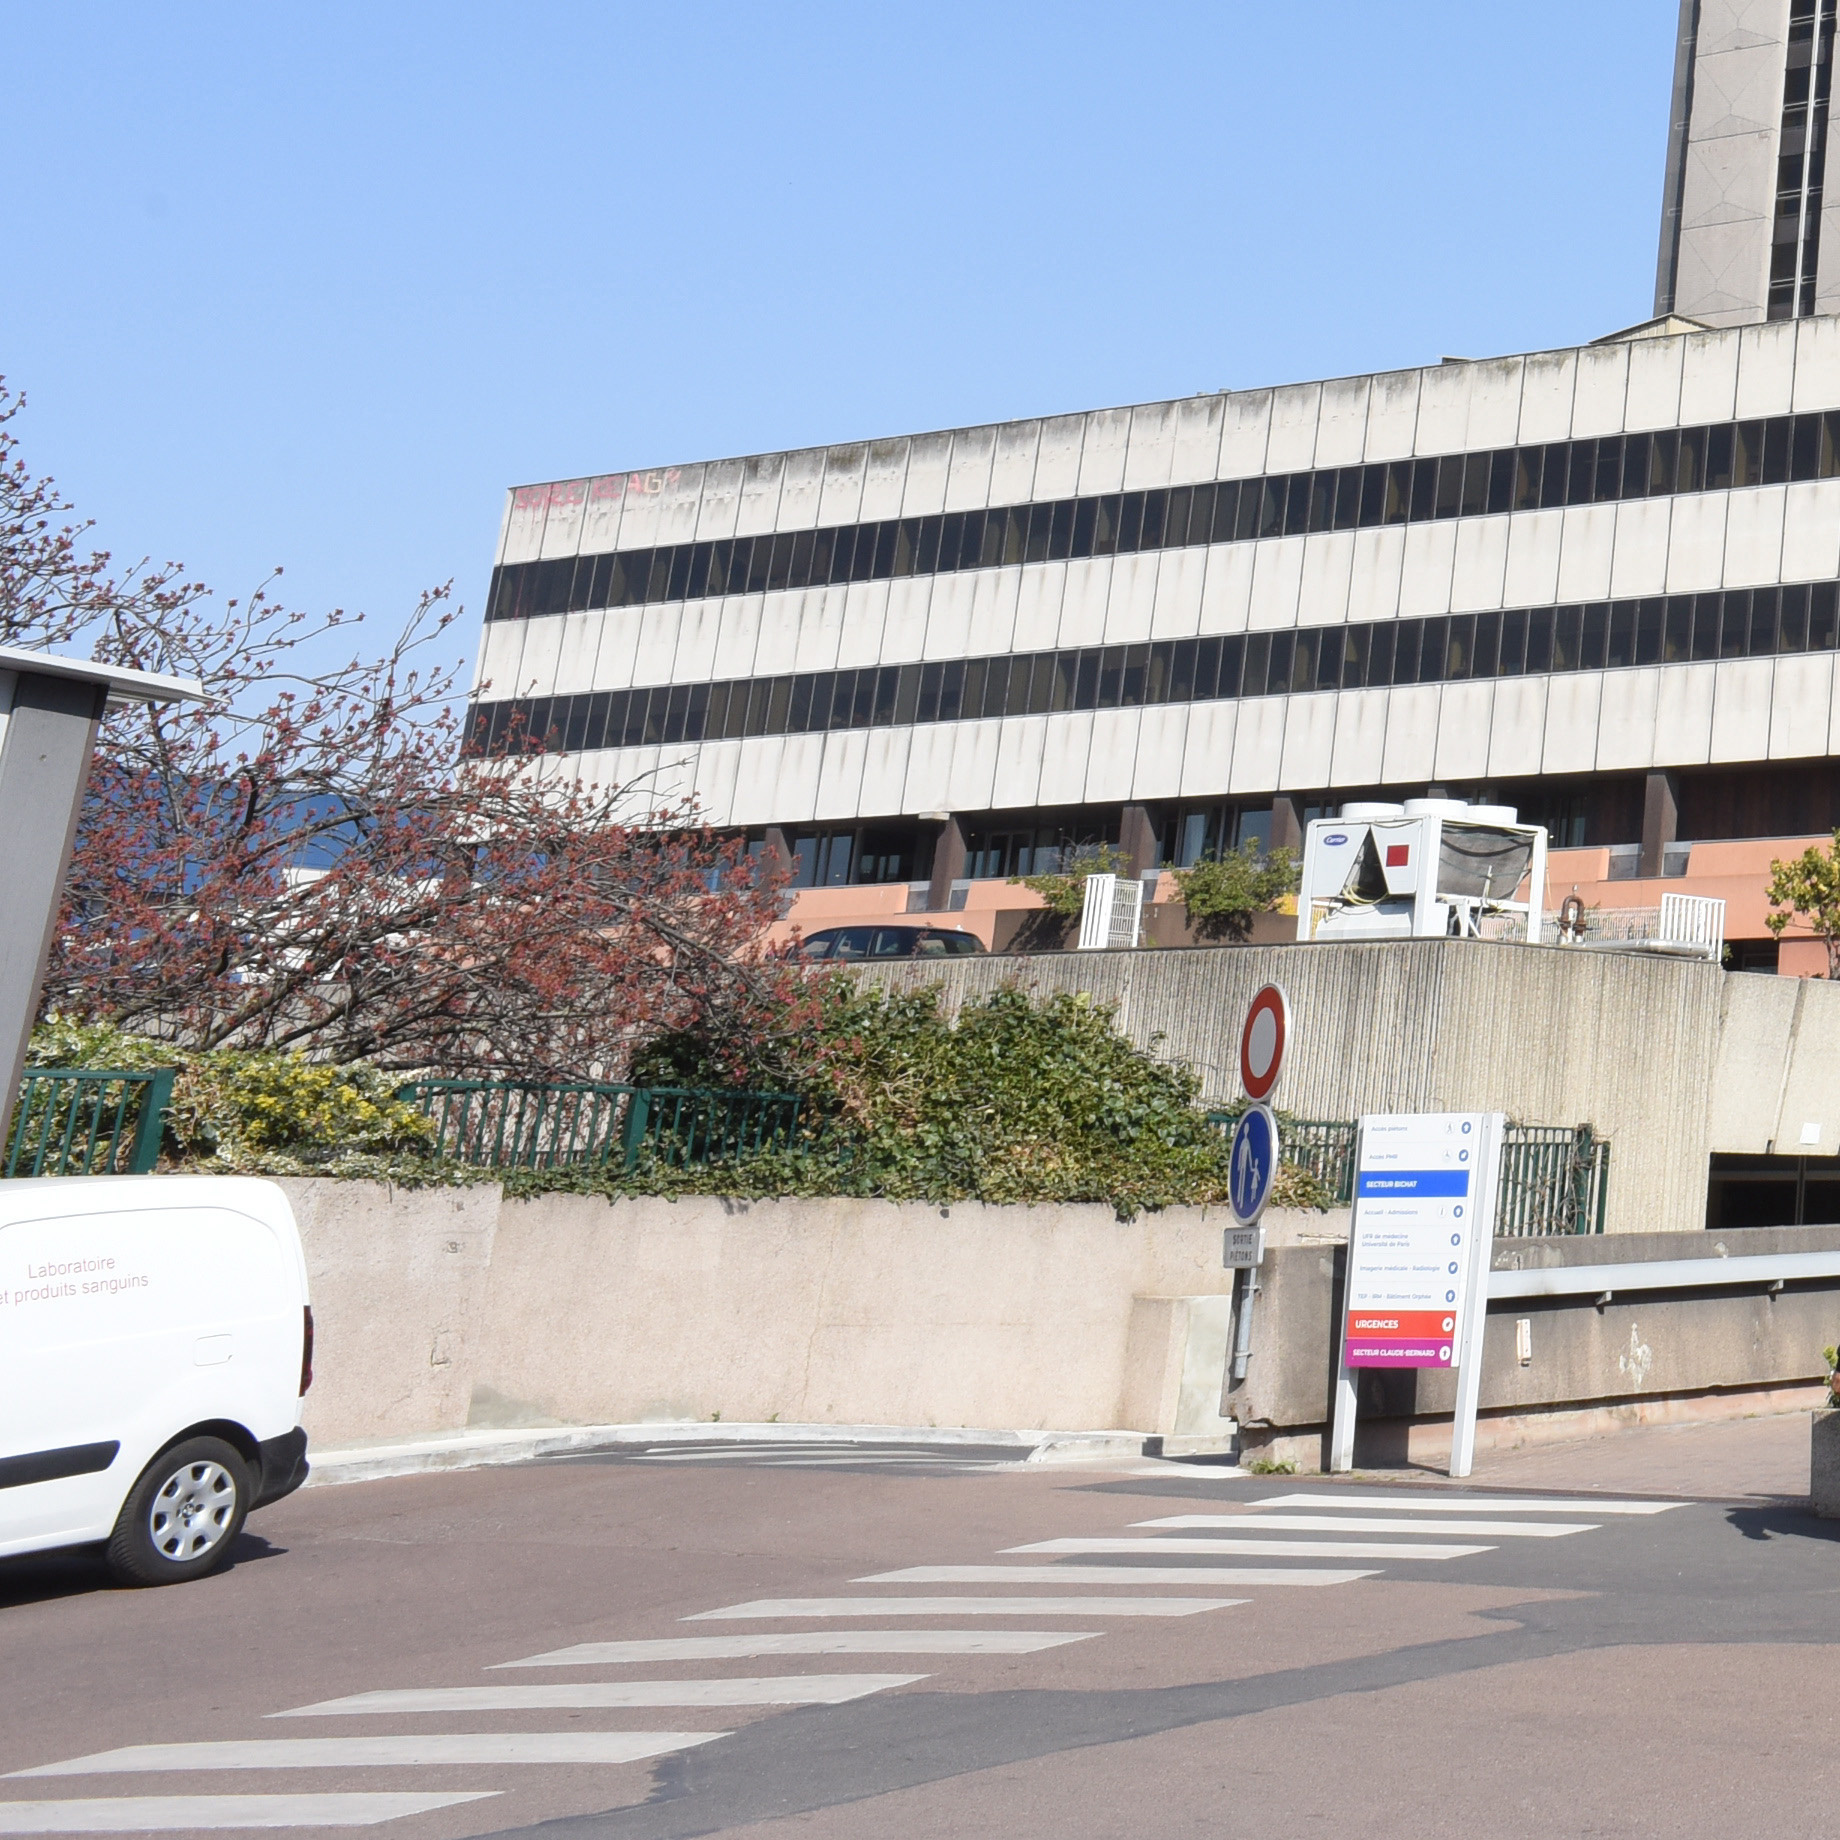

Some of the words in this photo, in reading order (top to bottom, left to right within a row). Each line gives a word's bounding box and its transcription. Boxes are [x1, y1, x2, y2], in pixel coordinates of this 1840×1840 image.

[1366, 1180, 1394, 1188] SECTEUR
[1394, 1180, 1418, 1188] BICHAT
[28, 1256, 116, 1279] Laboratoire
[14, 1282, 77, 1306] produits
[81, 1272, 149, 1295] sanguins
[1355, 1319, 1399, 1329] URGENCES
[1353, 1348, 1380, 1357] SECTEUR
